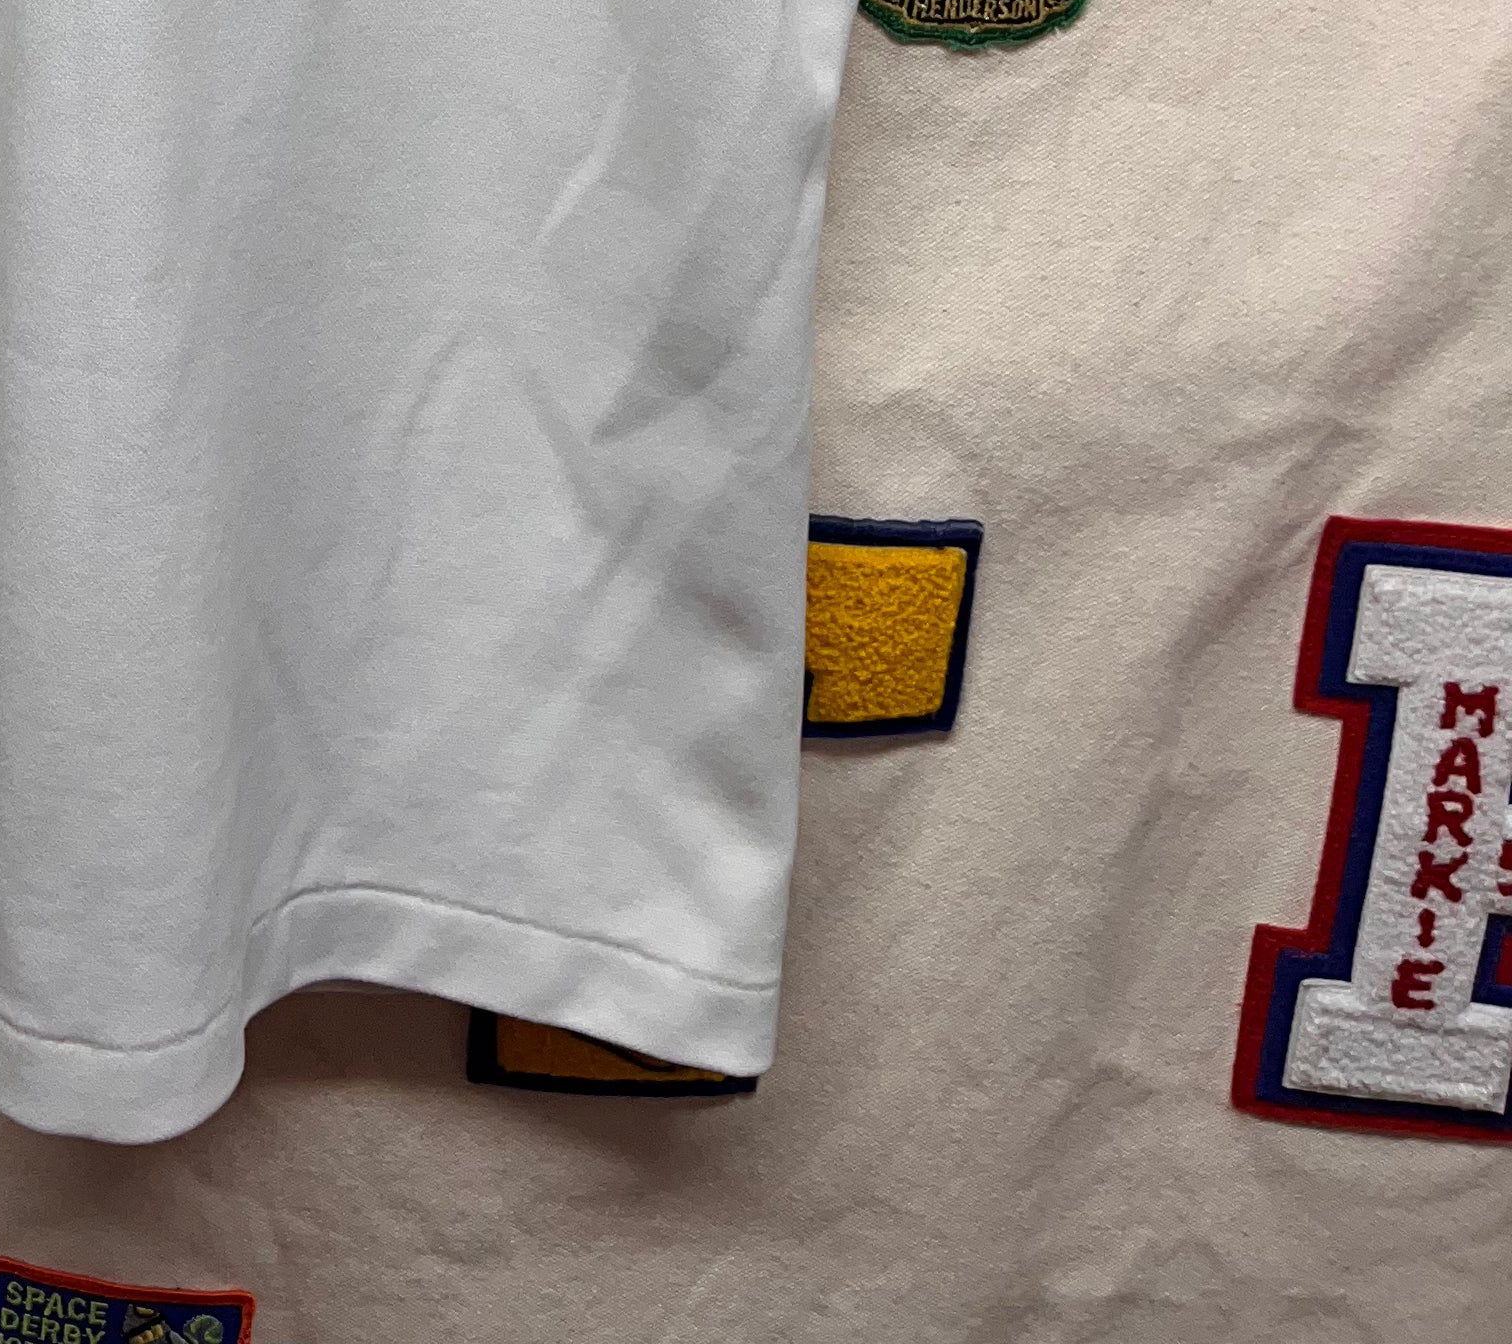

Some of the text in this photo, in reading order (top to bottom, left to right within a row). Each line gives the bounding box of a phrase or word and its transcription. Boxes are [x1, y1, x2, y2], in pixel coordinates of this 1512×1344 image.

[1390, 681, 1499, 1011] MARKIE
[0, 1306, 106, 1344] DERBY
[6, 1281, 109, 1326] SPACE
